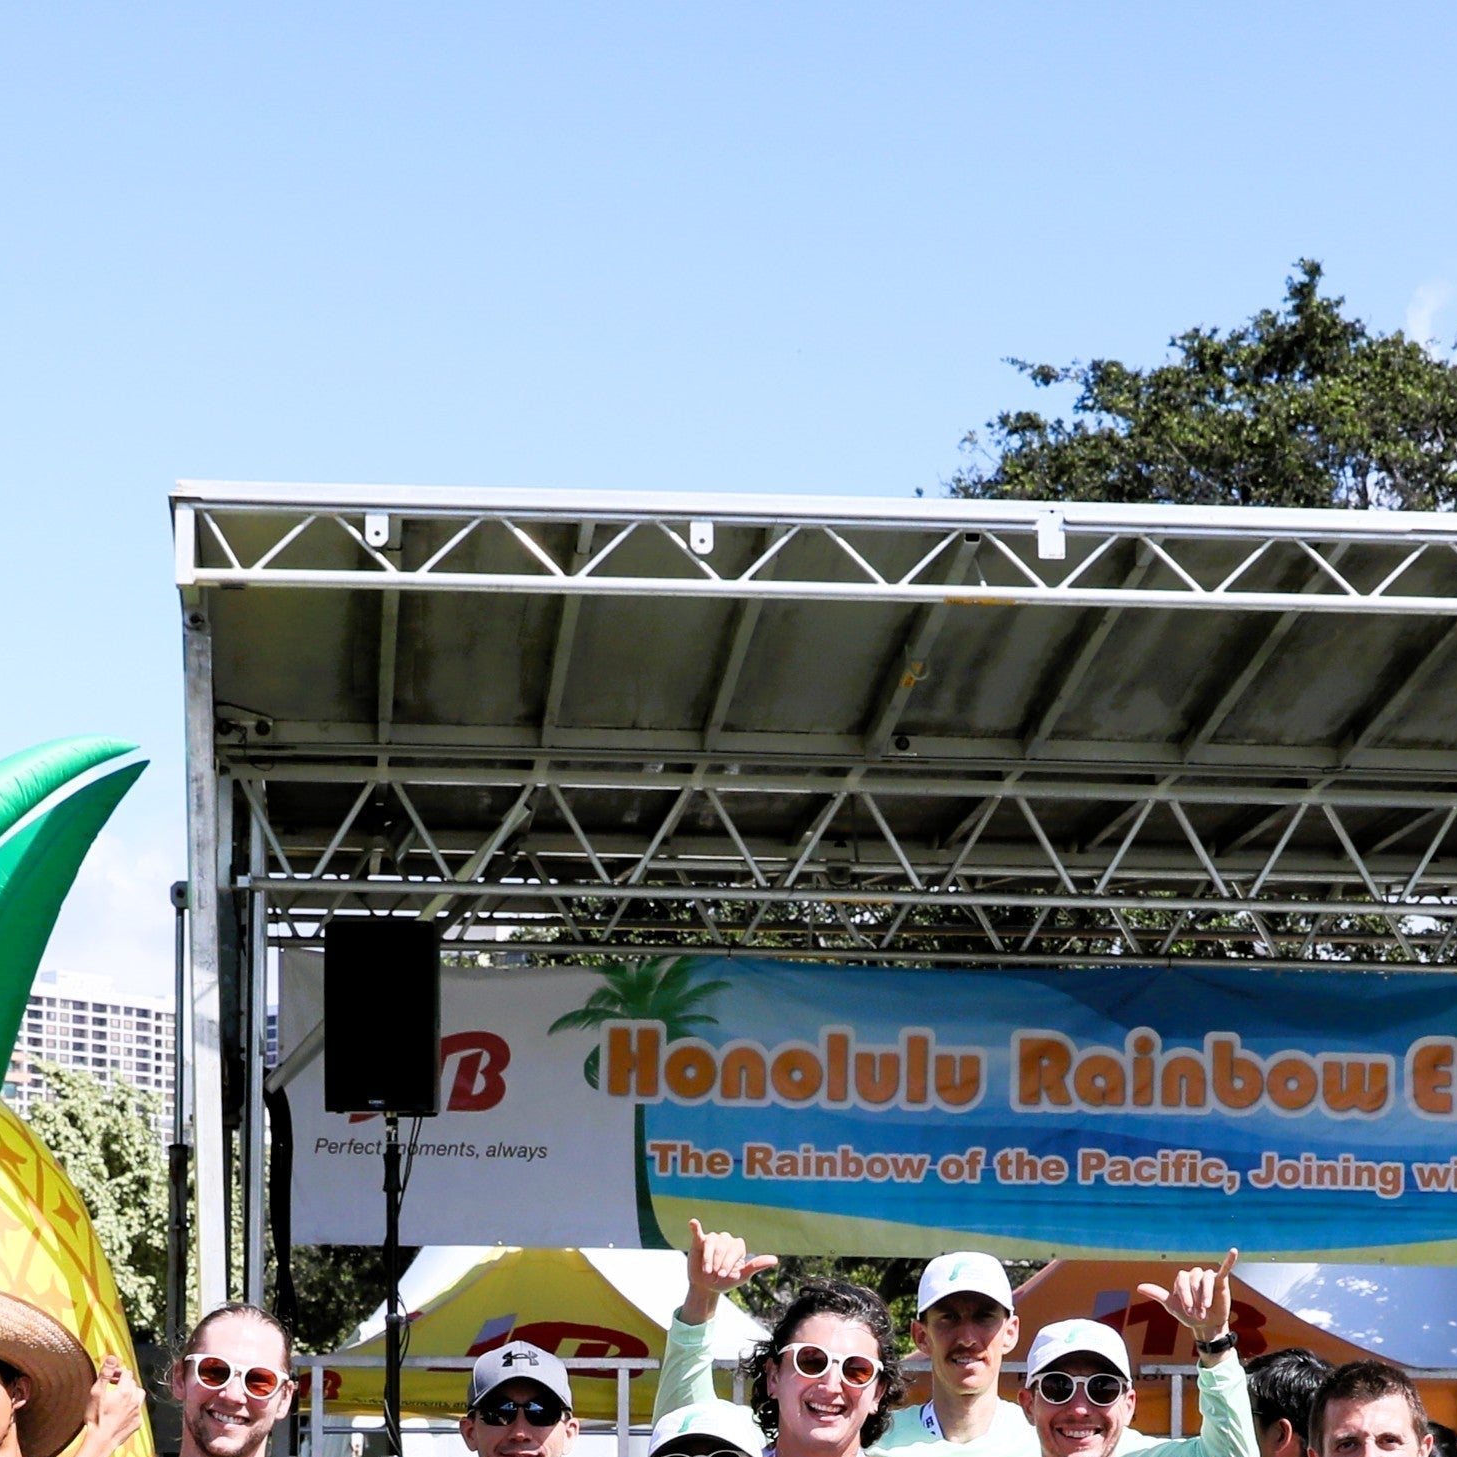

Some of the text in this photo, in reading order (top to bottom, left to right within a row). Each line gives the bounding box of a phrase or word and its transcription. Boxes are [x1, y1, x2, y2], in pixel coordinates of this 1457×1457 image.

[607, 1028, 981, 1106] Honolulu
[1019, 1035, 1389, 1112] Rainbow
[314, 1137, 382, 1156] Perfect
[485, 1142, 548, 1161] always
[650, 1143, 731, 1176] The
[746, 1146, 928, 1180] Rainbow
[941, 1150, 983, 1181] of
[998, 1152, 1066, 1182] the
[1081, 1153, 1237, 1191] Pacific,
[1251, 1156, 1402, 1196] Joining
